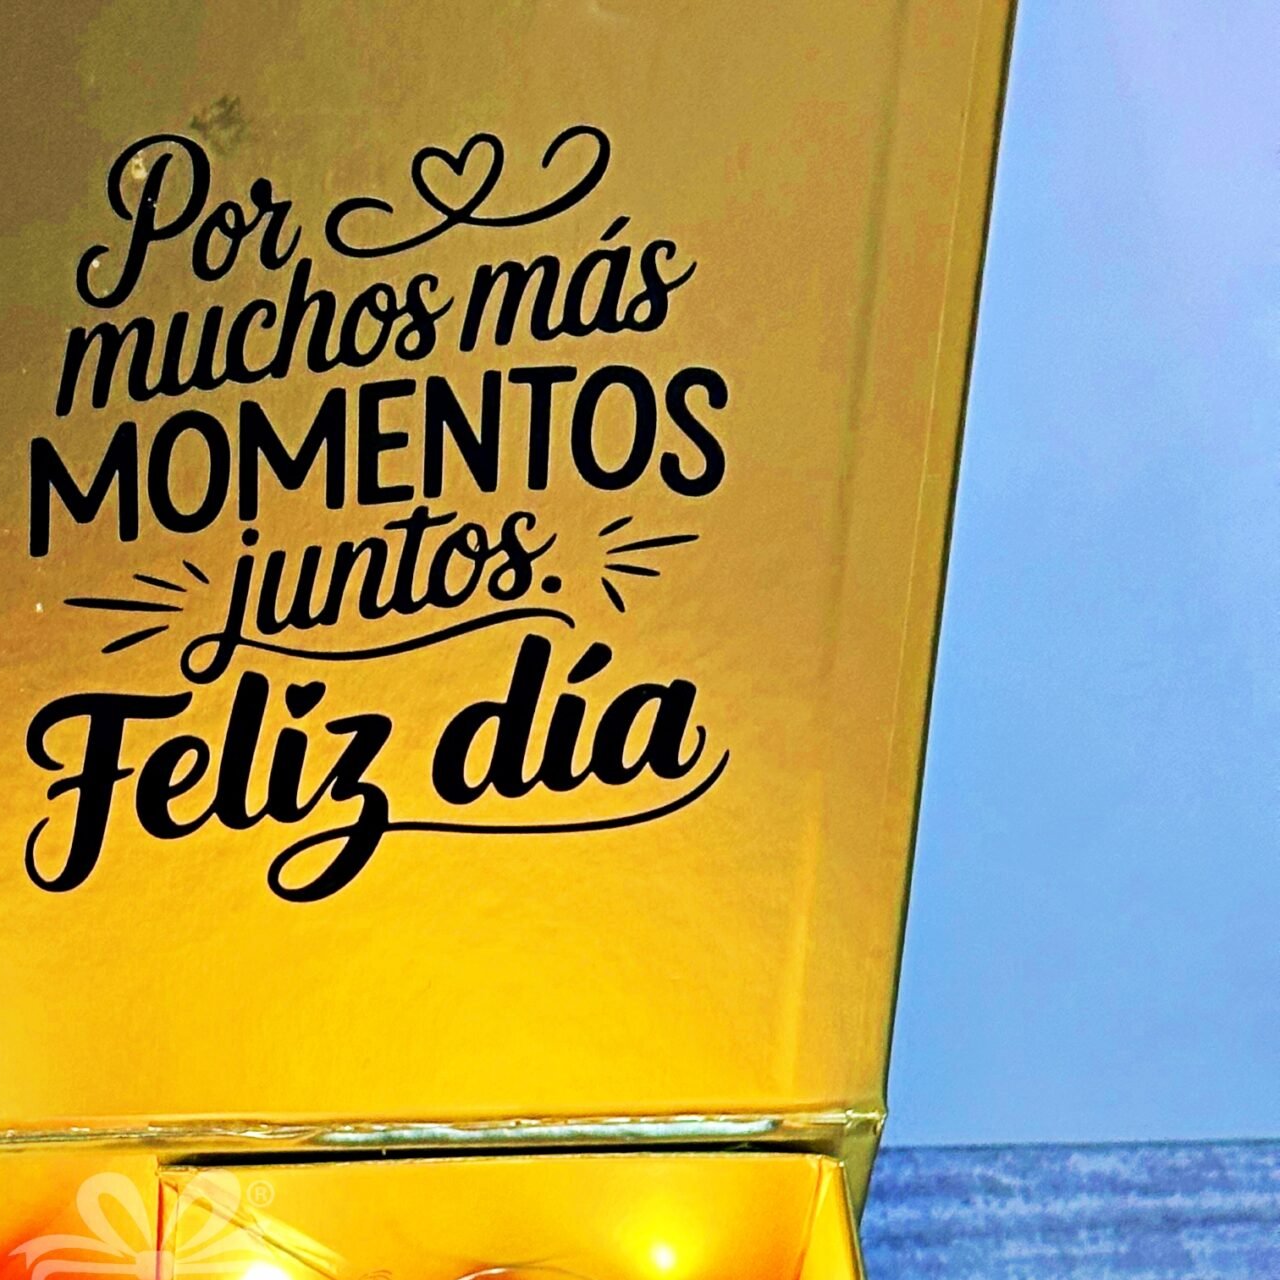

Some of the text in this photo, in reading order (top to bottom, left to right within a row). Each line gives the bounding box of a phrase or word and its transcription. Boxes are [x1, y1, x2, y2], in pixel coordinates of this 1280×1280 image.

[56, 216, 697, 417] muchos más
[76, 134, 302, 308] Por
[30, 366, 729, 557] MOMENTOS
[181, 506, 563, 684] juntos.
[25, 634, 706, 902] Feliz día
